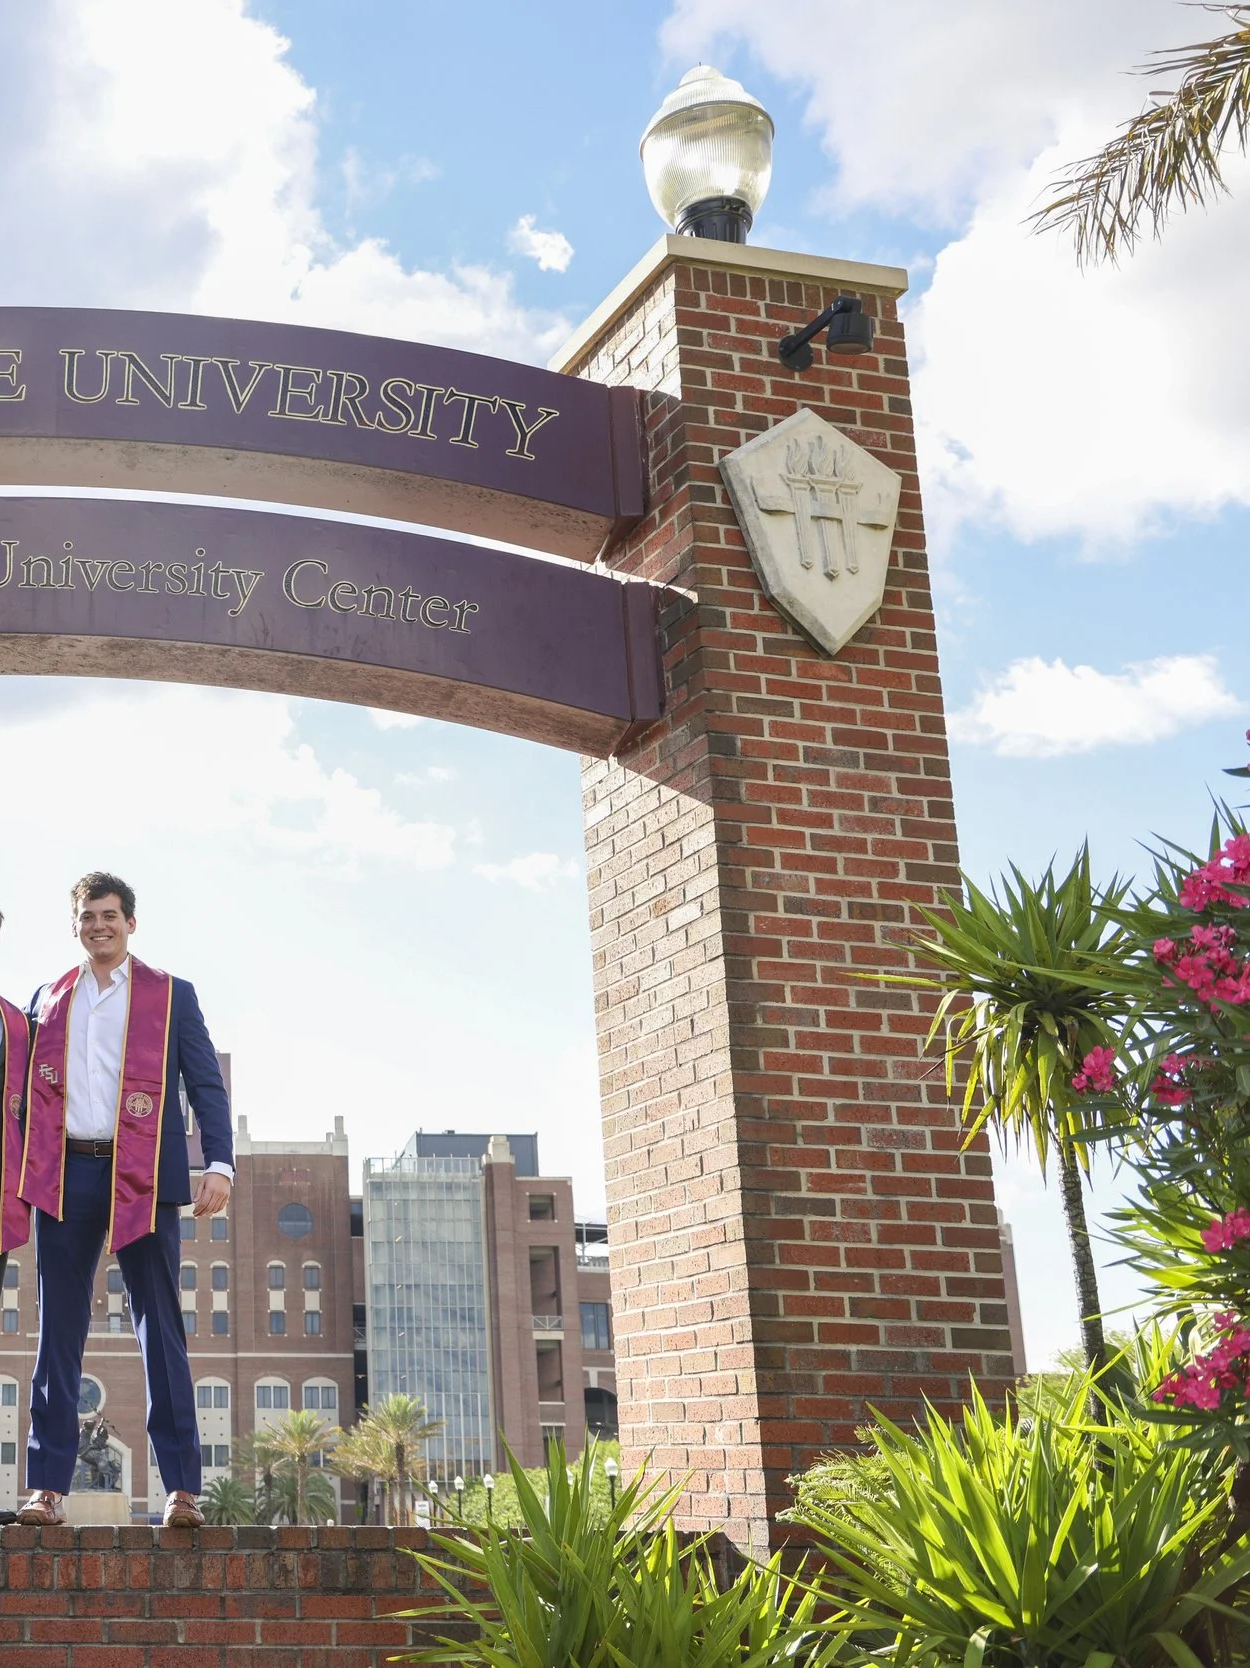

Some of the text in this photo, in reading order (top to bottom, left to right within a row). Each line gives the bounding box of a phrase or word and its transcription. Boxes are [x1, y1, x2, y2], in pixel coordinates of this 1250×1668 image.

[59, 349, 559, 461] UNIVERSITY
[282, 559, 480, 633] Center
[39, 1064, 58, 1084] FSU
